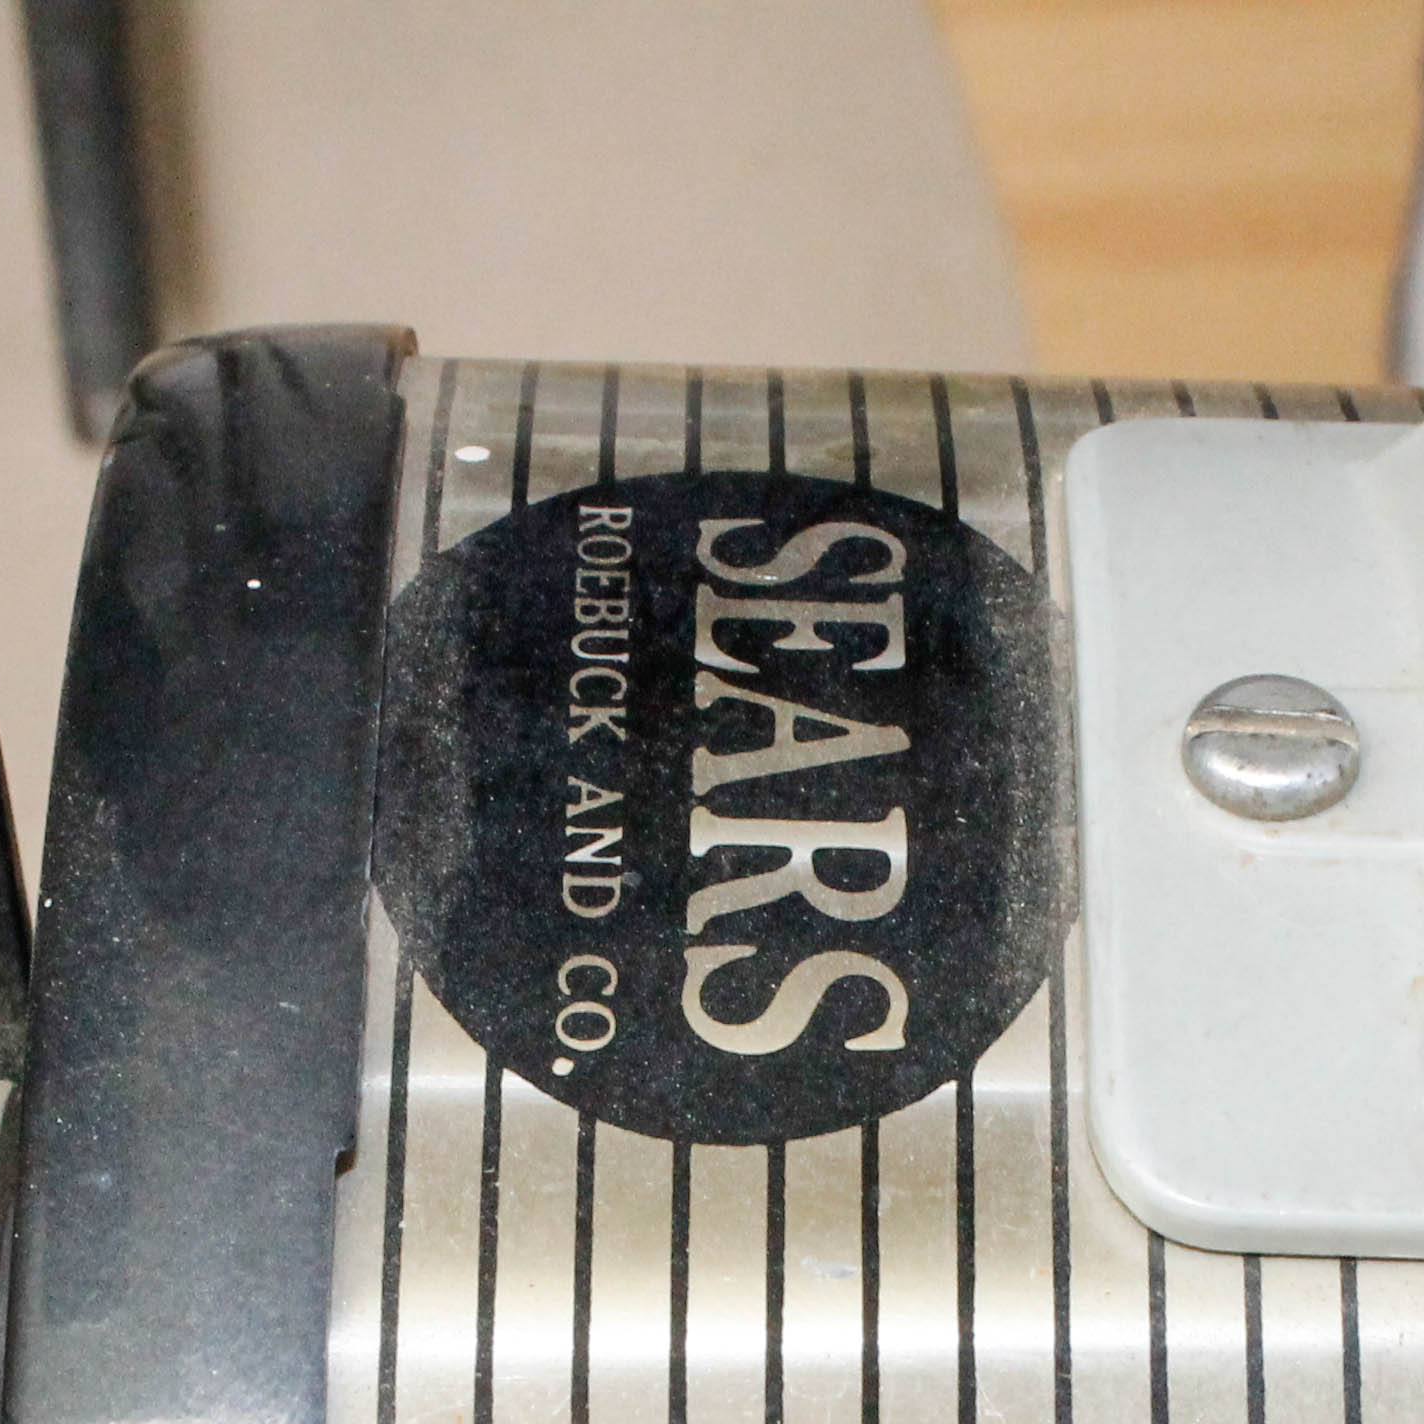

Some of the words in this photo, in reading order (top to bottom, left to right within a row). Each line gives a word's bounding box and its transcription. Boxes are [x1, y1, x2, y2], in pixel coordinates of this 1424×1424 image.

[567, 503, 634, 744] ROEBUCK
[560, 774, 624, 920] AND
[680, 516, 912, 1056] SEARS
[550, 953, 619, 1078] CO.
